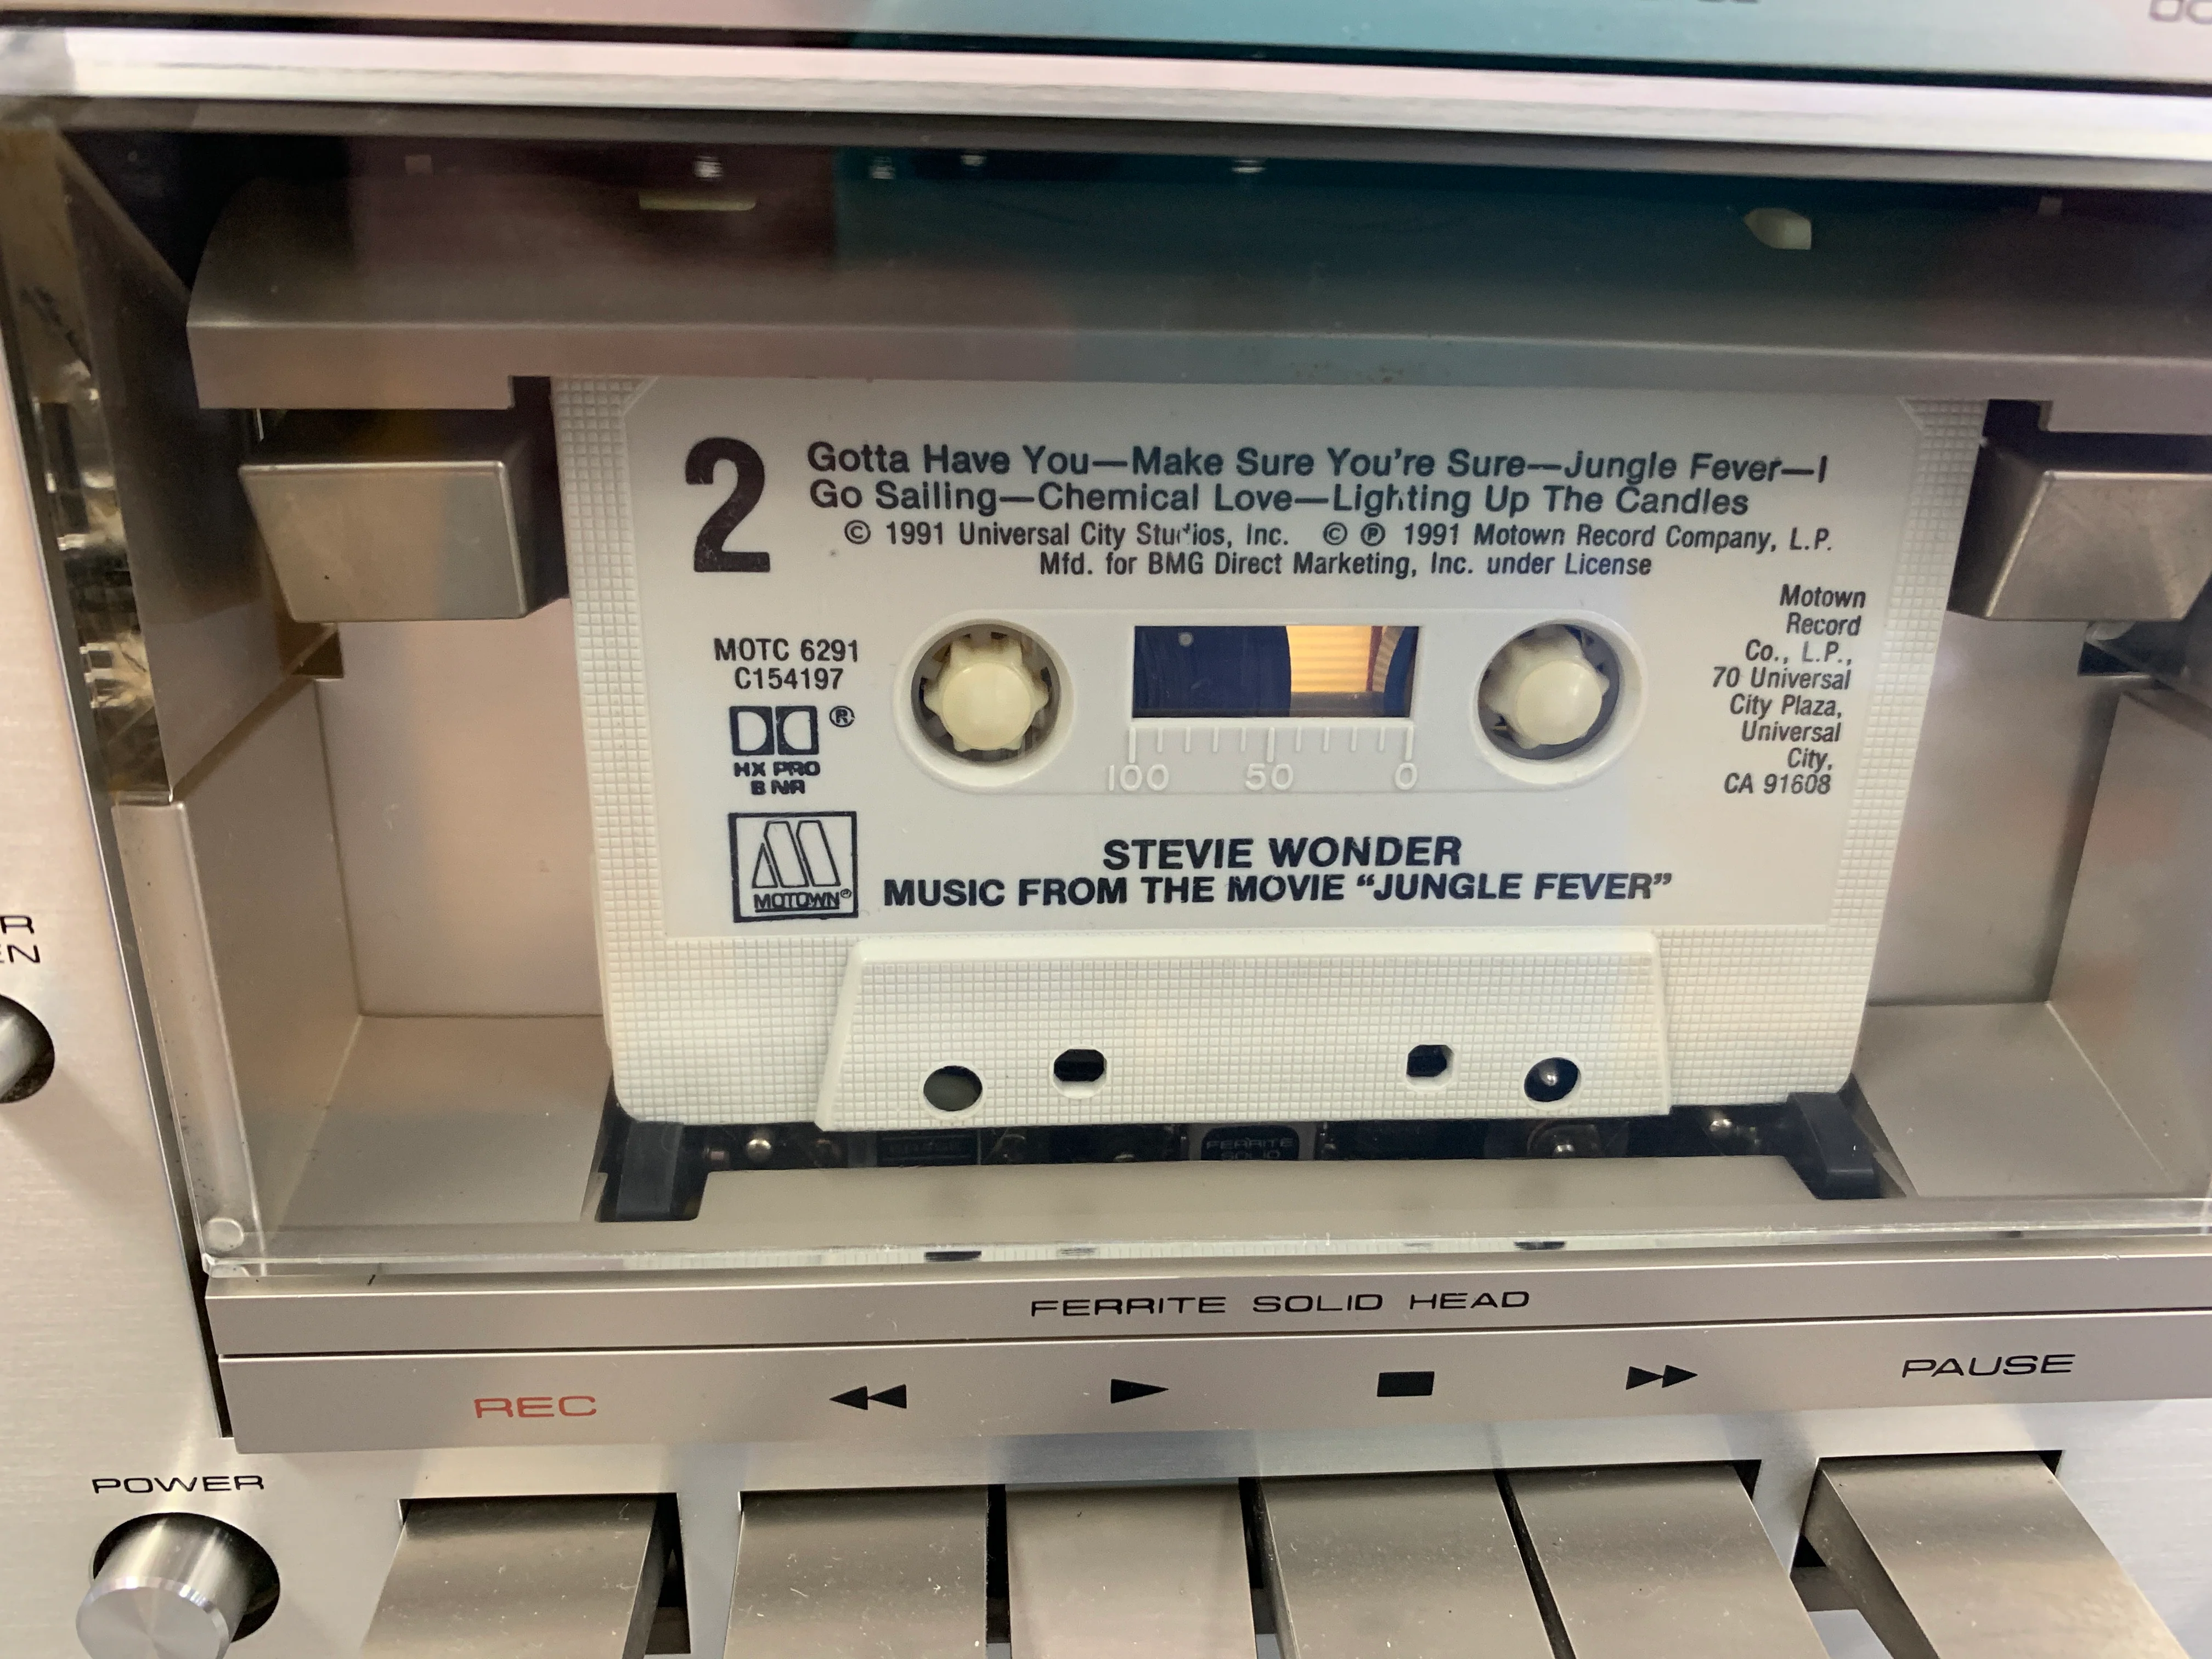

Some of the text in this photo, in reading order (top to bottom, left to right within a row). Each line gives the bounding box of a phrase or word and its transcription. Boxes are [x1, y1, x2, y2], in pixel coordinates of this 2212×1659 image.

[808, 441, 910, 473] Gotta
[924, 444, 1010, 474] Have
[1237, 447, 1314, 476] Sure
[685, 438, 770, 573] 2
[810, 479, 862, 508] Go
[1486, 485, 1530, 517] Up
[1543, 485, 1603, 512] The
[1616, 485, 1748, 515] Candles
[887, 521, 943, 545] 1991
[960, 522, 1069, 545] Universal
[1081, 522, 1125, 551] City
[1247, 523, 1288, 545] Inc.
[1405, 523, 1458, 545] 1991
[1474, 523, 1565, 545] Motown
[1577, 524, 1656, 546] Record
[1666, 525, 1776, 555] Company,
[1790, 527, 1831, 551] L.P.
[1041, 551, 1651, 579] Mfd. for BMG Direct Marketing, Inc. under License
[1780, 584, 1866, 608] Motown
[1786, 612, 1861, 636] Record
[714, 637, 858, 662] MOTC 6291
[1746, 639, 1852, 666] Co., L.P.,
[735, 667, 844, 690] C154197
[1712, 667, 1852, 690] 70 Universal
[1730, 693, 1842, 720] City Plaza,
[1742, 720, 1841, 742] Universal
[733, 761, 821, 777] HX PRO
[1787, 747, 1833, 773] City,
[1108, 762, 1418, 791] 100 50 0
[1724, 773, 1831, 794] CA 91608
[1103, 836, 1462, 870] STEVIE WONDER
[884, 879, 1005, 906] MUSIC
[1019, 877, 1127, 906] FROM
[1141, 877, 1214, 904] THE
[1228, 874, 1345, 902] MOVIE
[1031, 1291, 1529, 1317] FERRITE SOLID HEAD
[1902, 1354, 2075, 1378] PAUSE
[475, 1396, 596, 1418] REC
[92, 1475, 264, 1494] POWER
